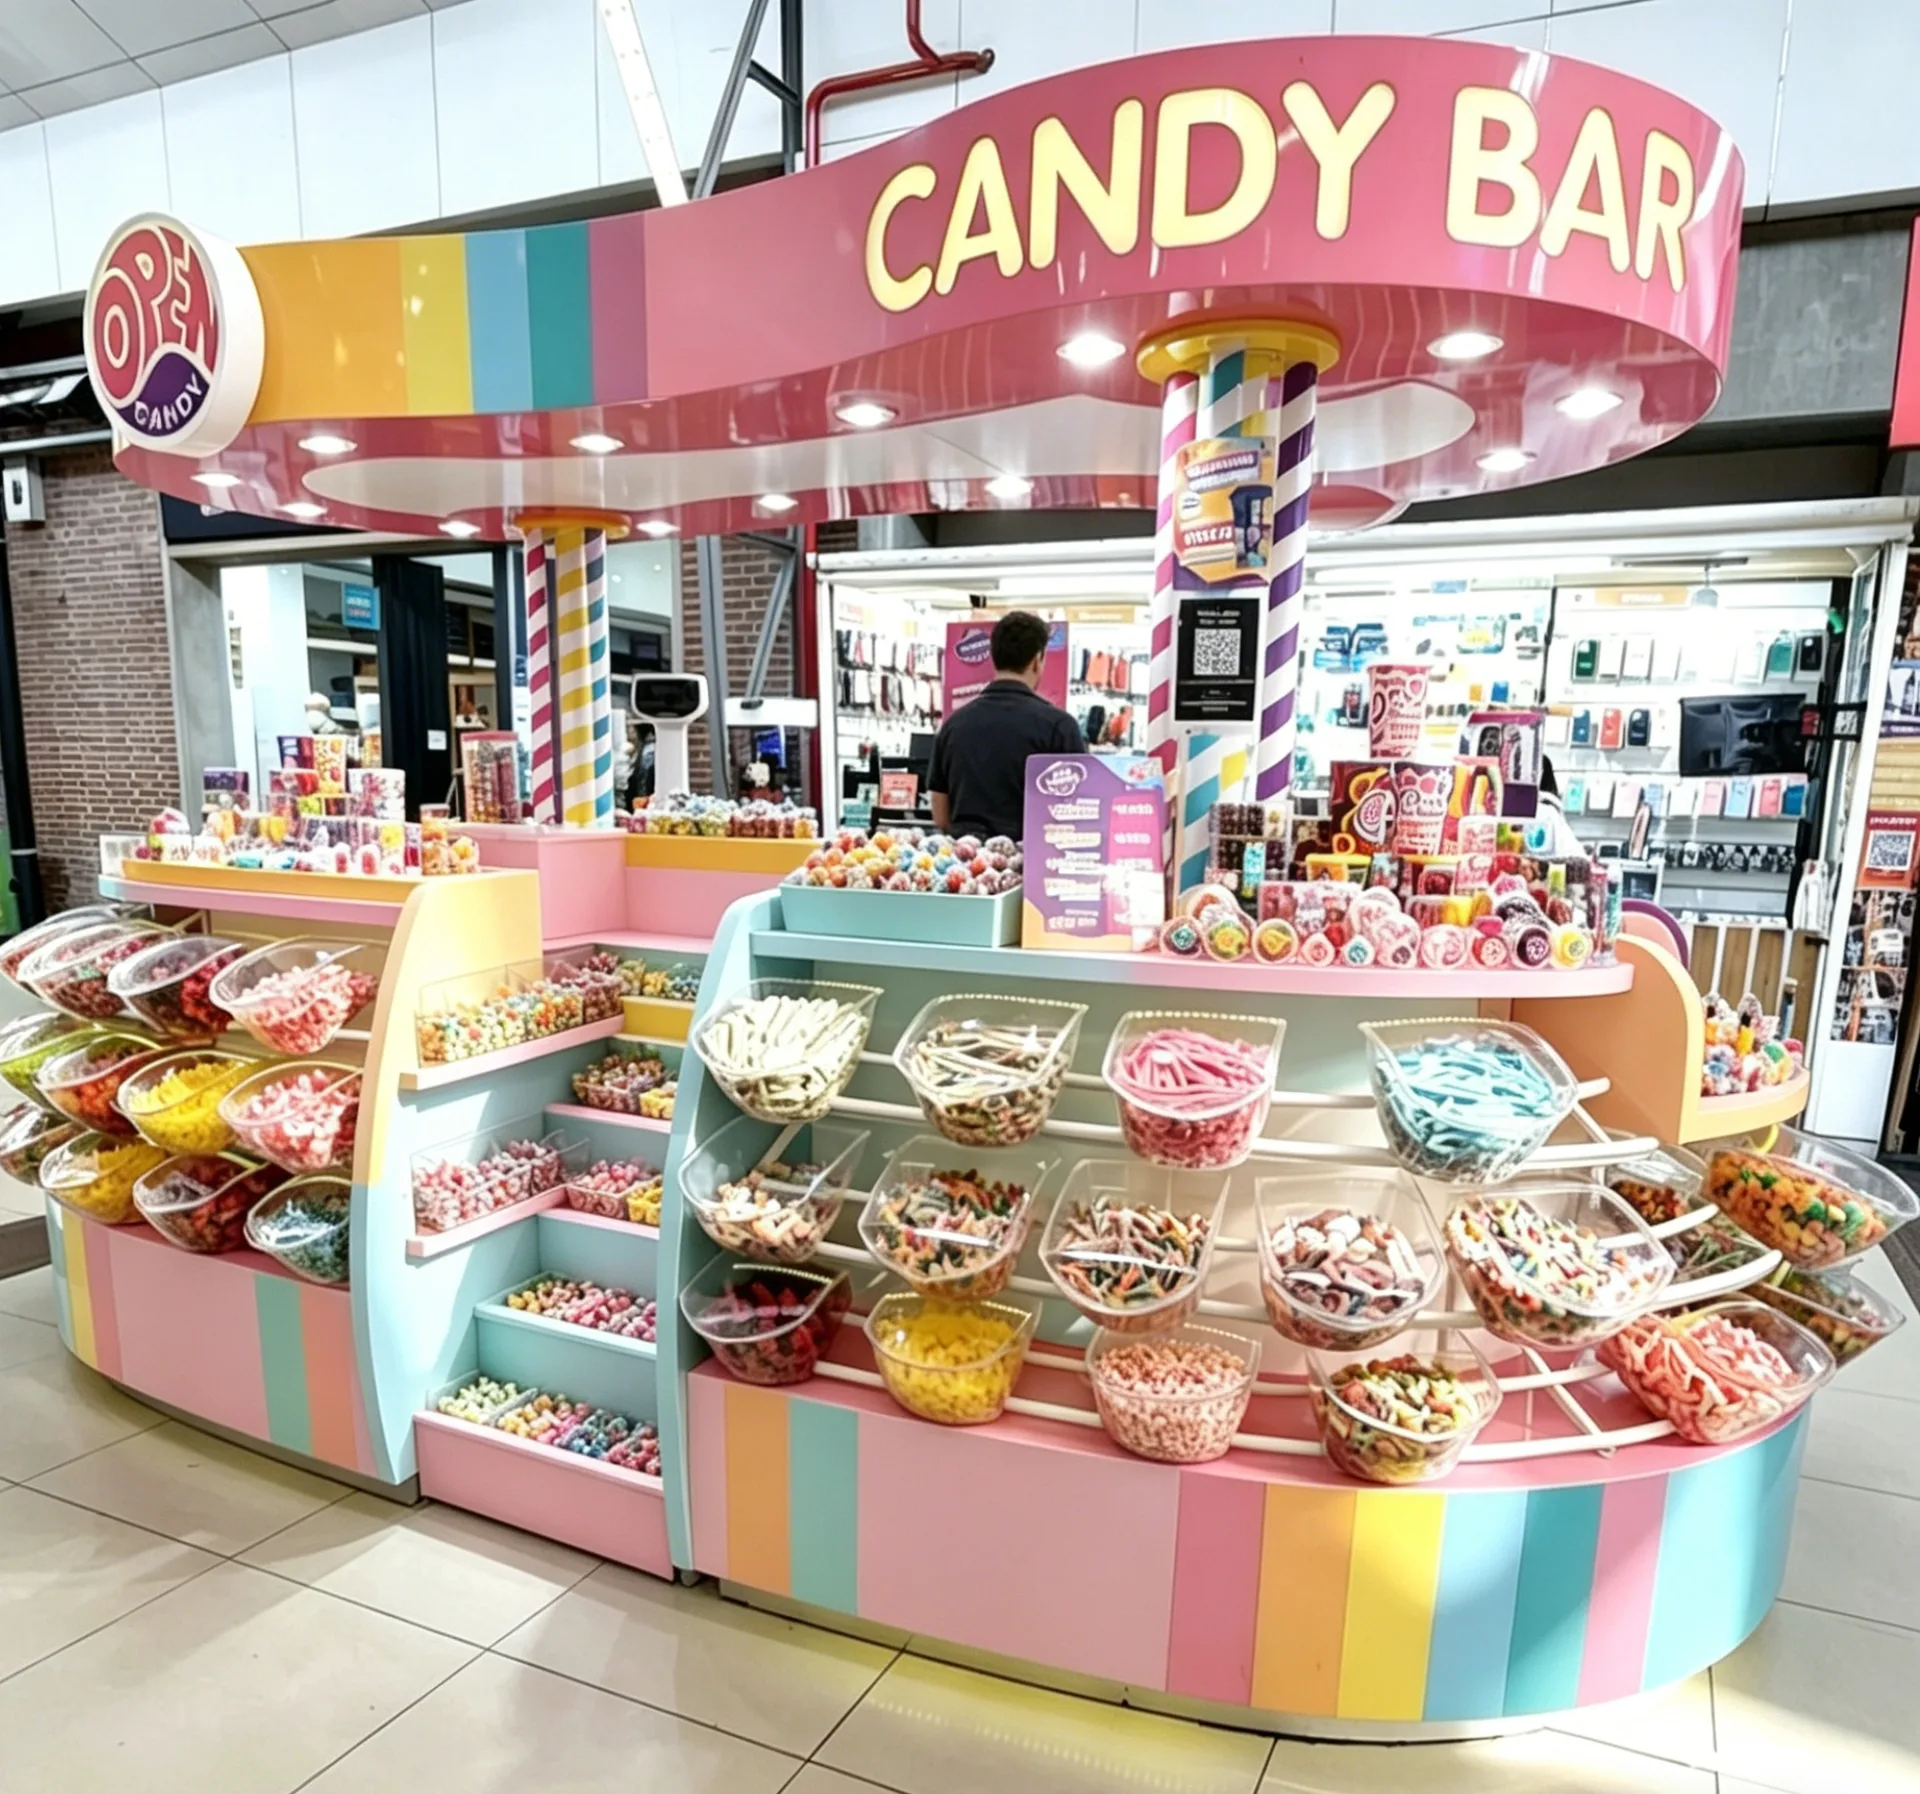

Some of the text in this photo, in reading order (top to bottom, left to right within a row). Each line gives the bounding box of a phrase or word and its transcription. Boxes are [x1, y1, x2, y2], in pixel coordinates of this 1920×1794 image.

[866, 81, 1695, 312] CANDY BAR
[134, 373, 202, 430] CANDY
